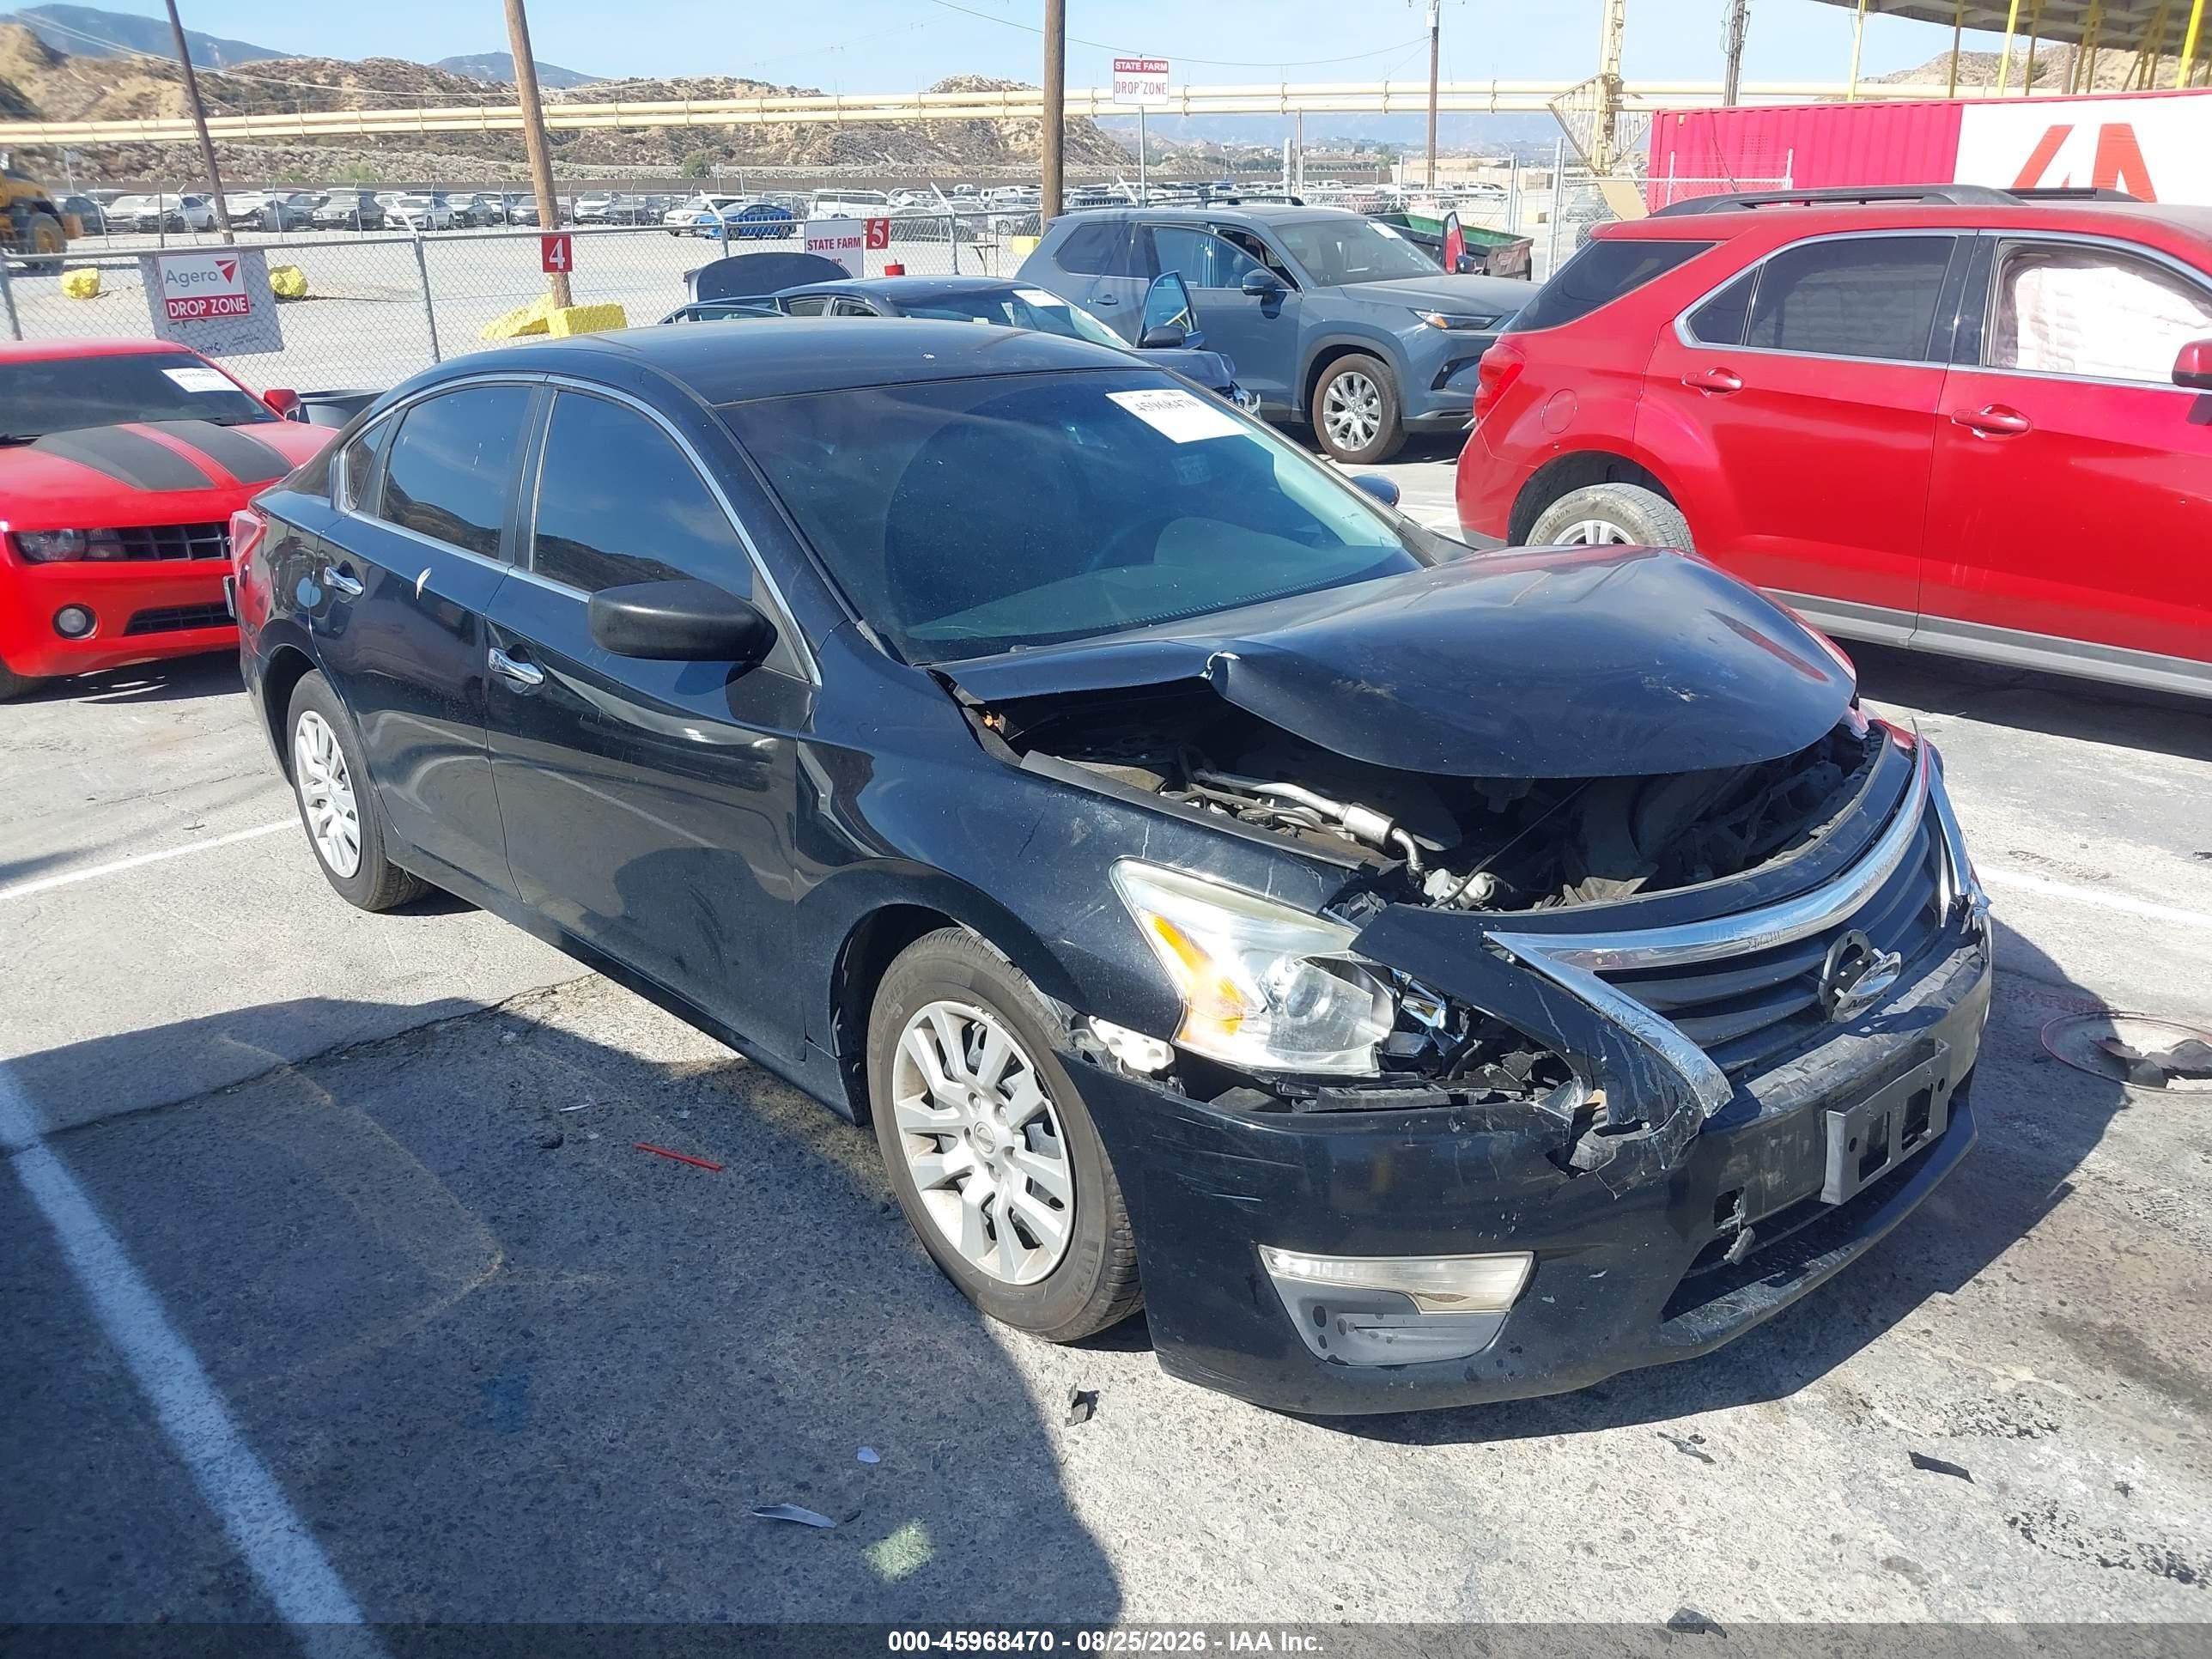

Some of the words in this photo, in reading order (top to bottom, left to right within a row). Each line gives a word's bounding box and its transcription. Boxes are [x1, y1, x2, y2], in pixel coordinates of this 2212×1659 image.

[1115, 61, 1141, 70] STATE
[1143, 62, 1167, 70] FARM
[1115, 81, 1139, 94] DROP
[1143, 82, 1167, 94] ZONE
[871, 221, 884, 247] 5
[549, 238, 566, 269] 4
[807, 238, 835, 251] STATE
[837, 237, 861, 249] FARM
[165, 269, 218, 288] Agero
[168, 300, 207, 317] DROP
[210, 297, 247, 314] ZONE
